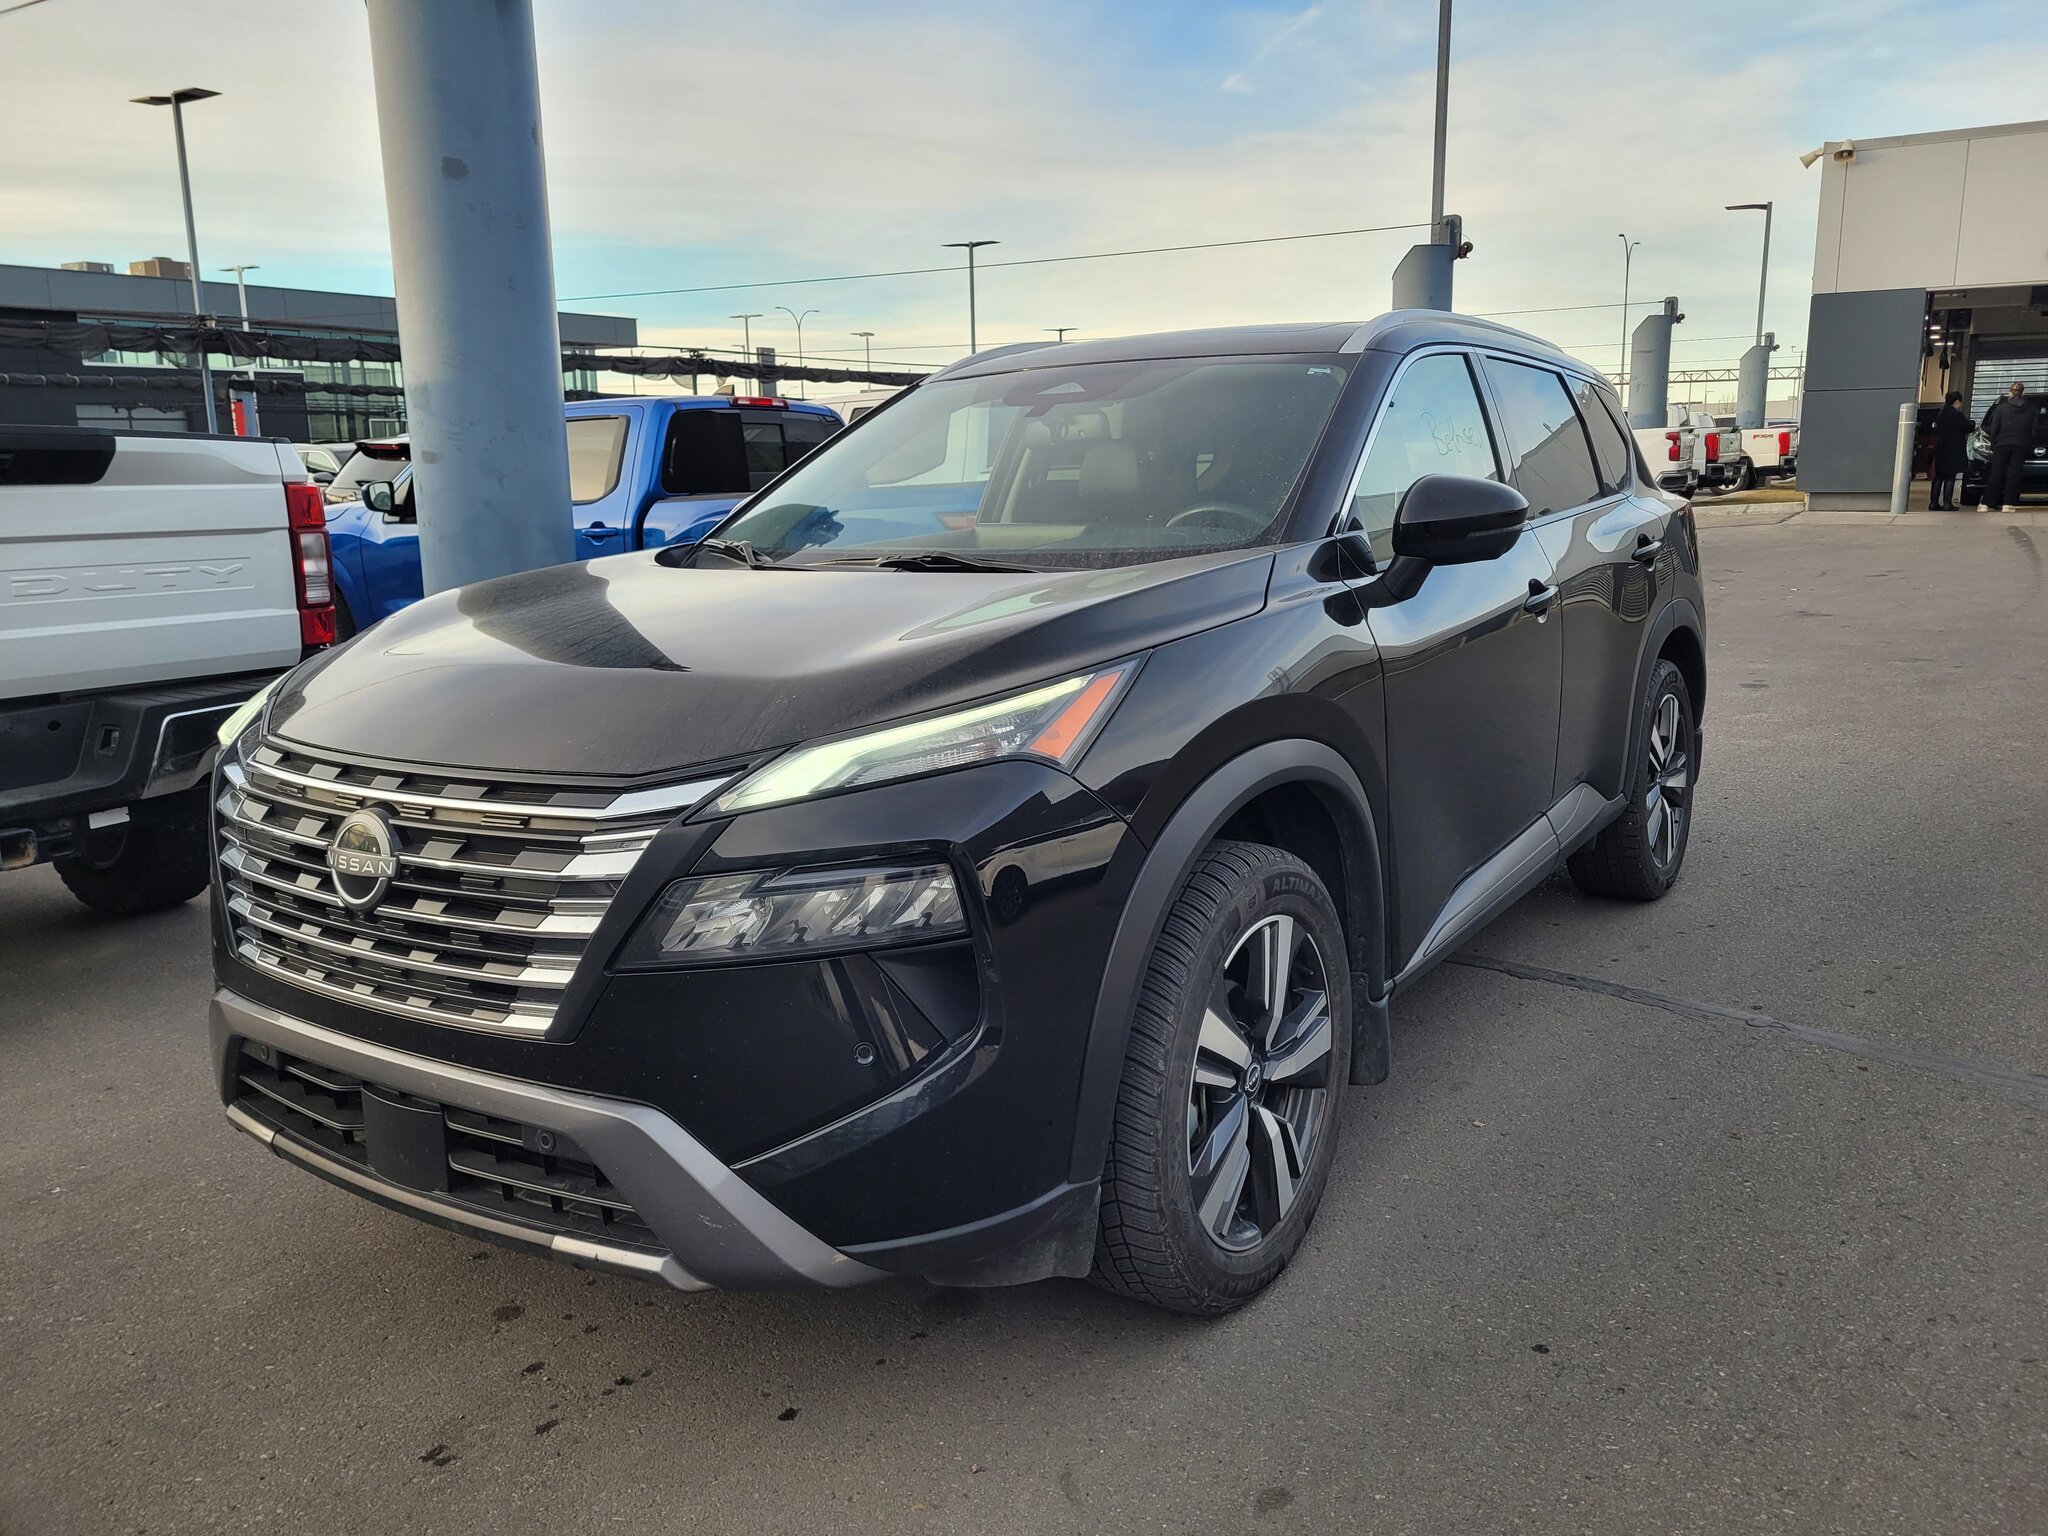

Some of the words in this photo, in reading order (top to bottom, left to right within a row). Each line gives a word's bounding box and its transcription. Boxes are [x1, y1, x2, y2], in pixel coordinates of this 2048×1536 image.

[10, 564, 243, 598] DUTY
[327, 850, 393, 875] NISSAN
[1273, 877, 1322, 903] ALTIMAX
